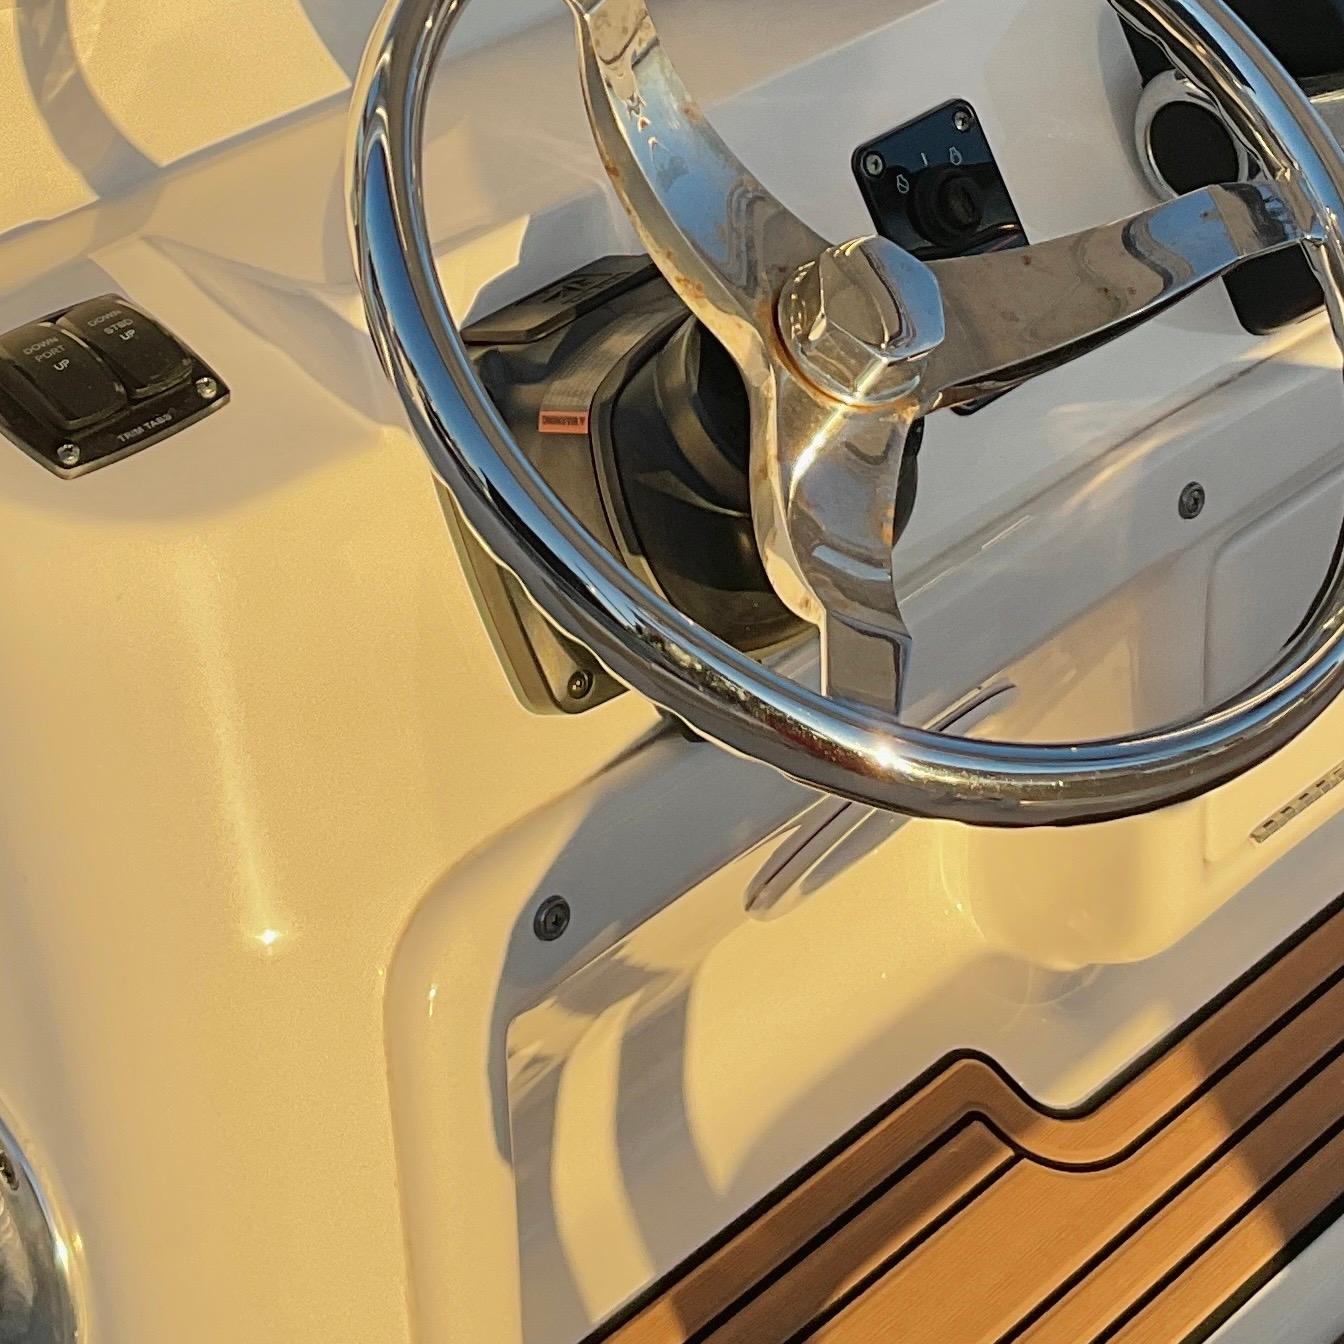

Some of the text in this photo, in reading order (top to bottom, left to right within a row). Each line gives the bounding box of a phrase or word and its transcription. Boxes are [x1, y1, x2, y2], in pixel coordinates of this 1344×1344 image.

[88, 310, 122, 327] DOWN
[119, 329, 136, 341] UP
[23, 337, 59, 355] DOWN
[35, 345, 66, 363] PORT
[53, 358, 70, 371] UP
[117, 413, 173, 443] TRIM TABS
